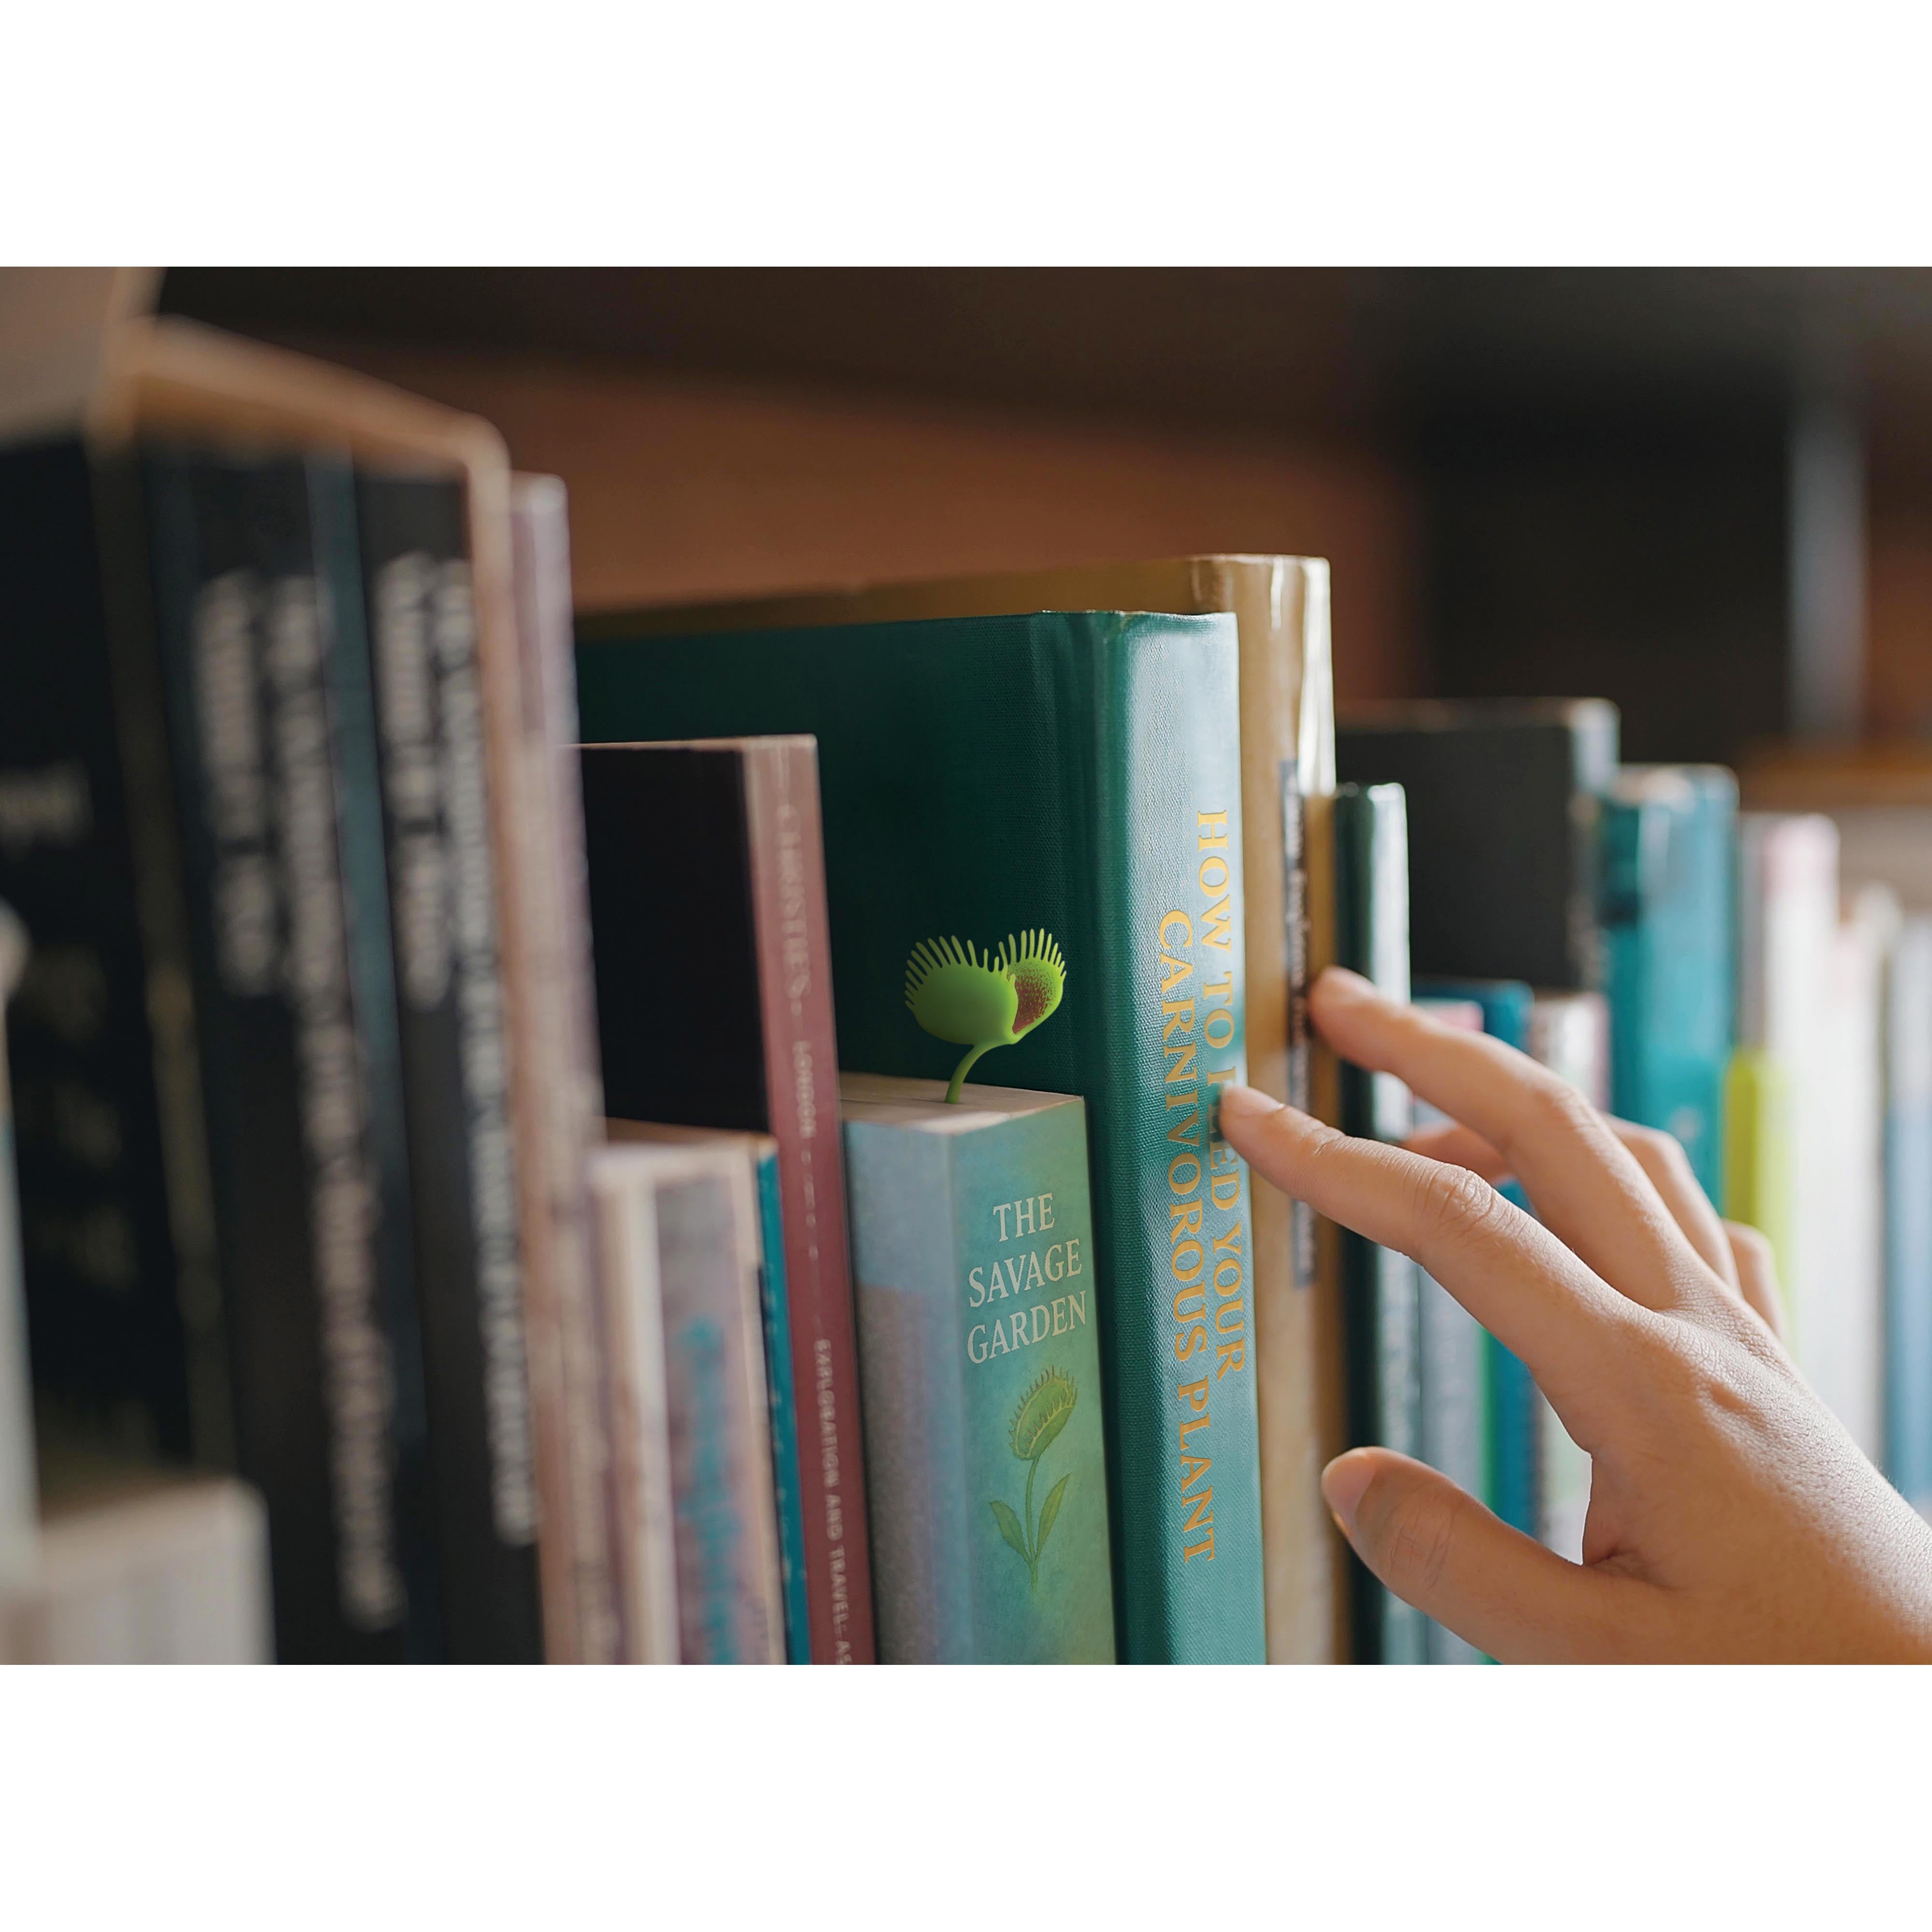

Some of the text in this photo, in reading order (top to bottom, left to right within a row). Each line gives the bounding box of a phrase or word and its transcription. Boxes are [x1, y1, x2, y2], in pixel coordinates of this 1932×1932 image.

[1197, 809, 1246, 1382] HOW TO FED YOUR
[993, 1192, 1055, 1242] THE
[1159, 909, 1215, 1564] CARNIVOROUS PLANT
[968, 1238, 1082, 1308] SAVAGE
[967, 1290, 1087, 1364] GARDEN
